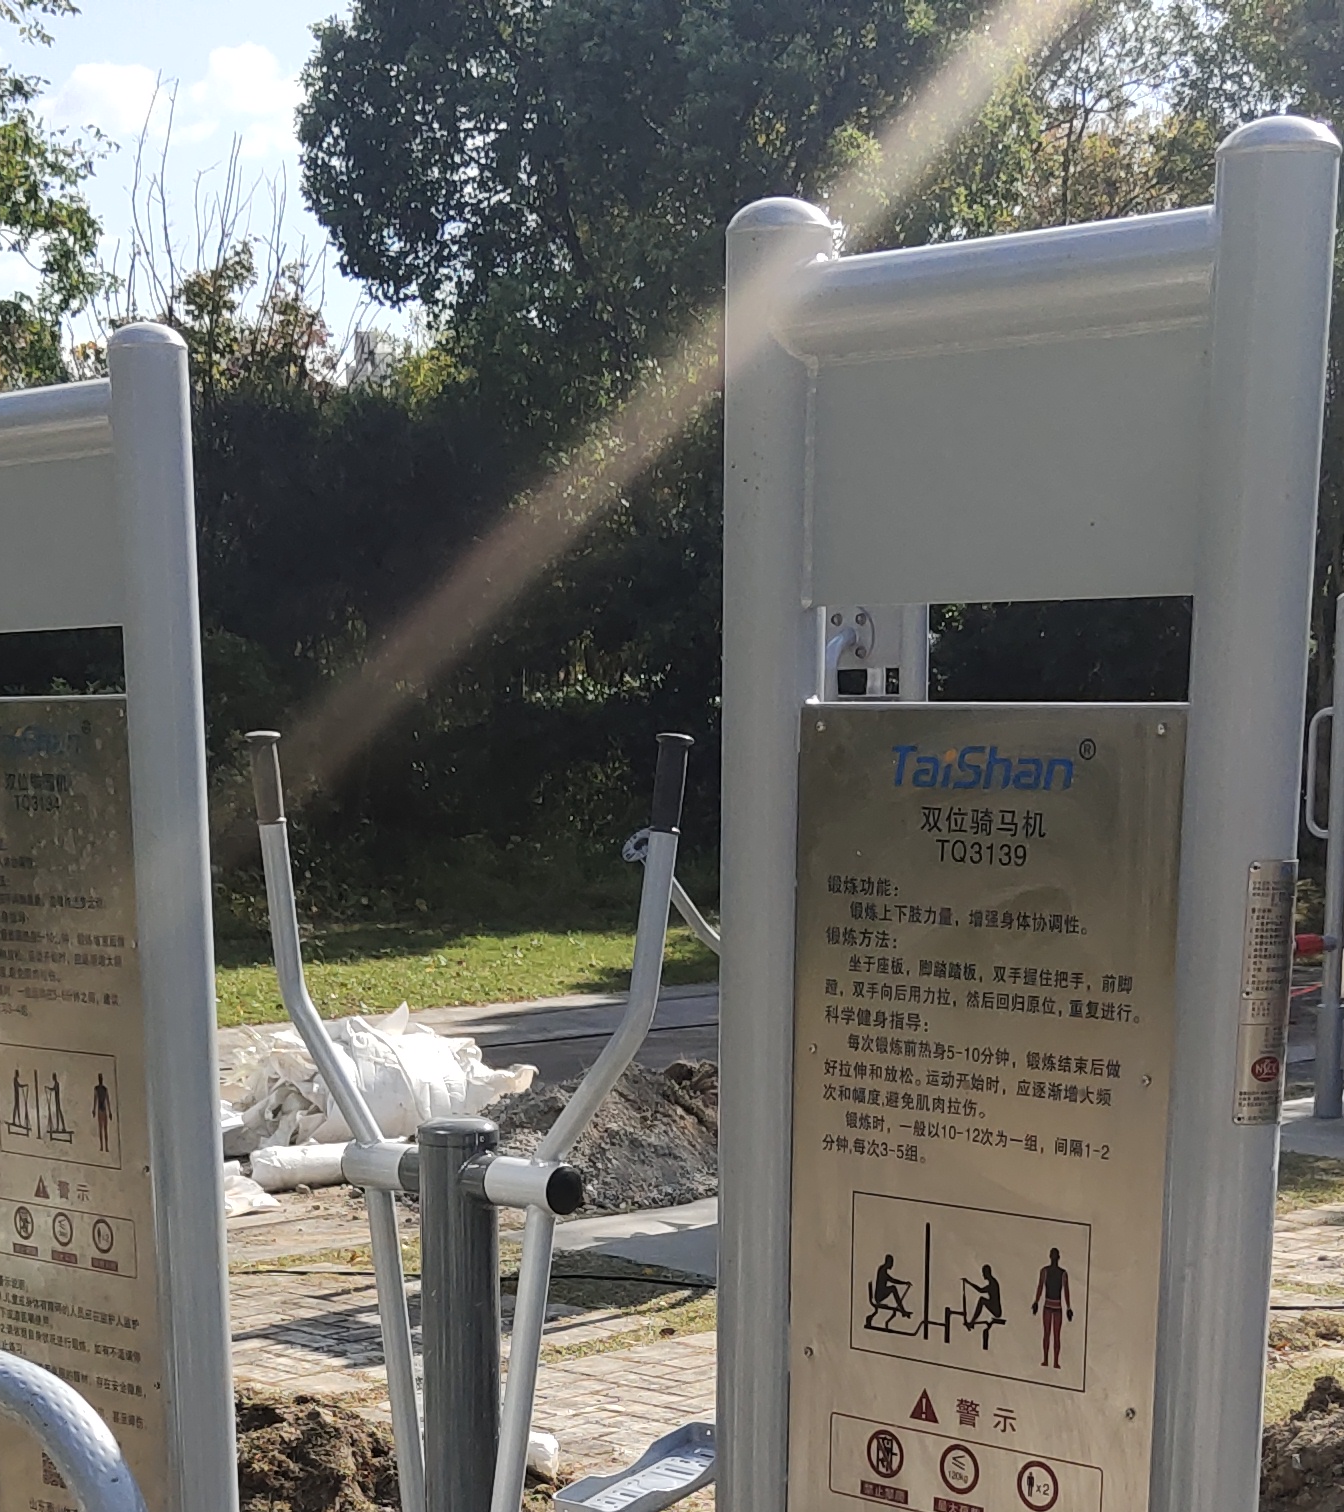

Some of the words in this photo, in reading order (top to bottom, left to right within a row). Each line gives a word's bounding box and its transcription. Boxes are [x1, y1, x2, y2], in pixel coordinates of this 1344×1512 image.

[892, 745, 1074, 790] TaiShan
[920, 806, 1046, 838] 双位骑马机
[935, 839, 1027, 866] TQ3139
[827, 875, 899, 897] 锻炼功能：
[826, 926, 897, 949] 锻炼方法：
[824, 1005, 928, 1032] 科学健身指导：
[956, 1397, 1017, 1433] 警示
